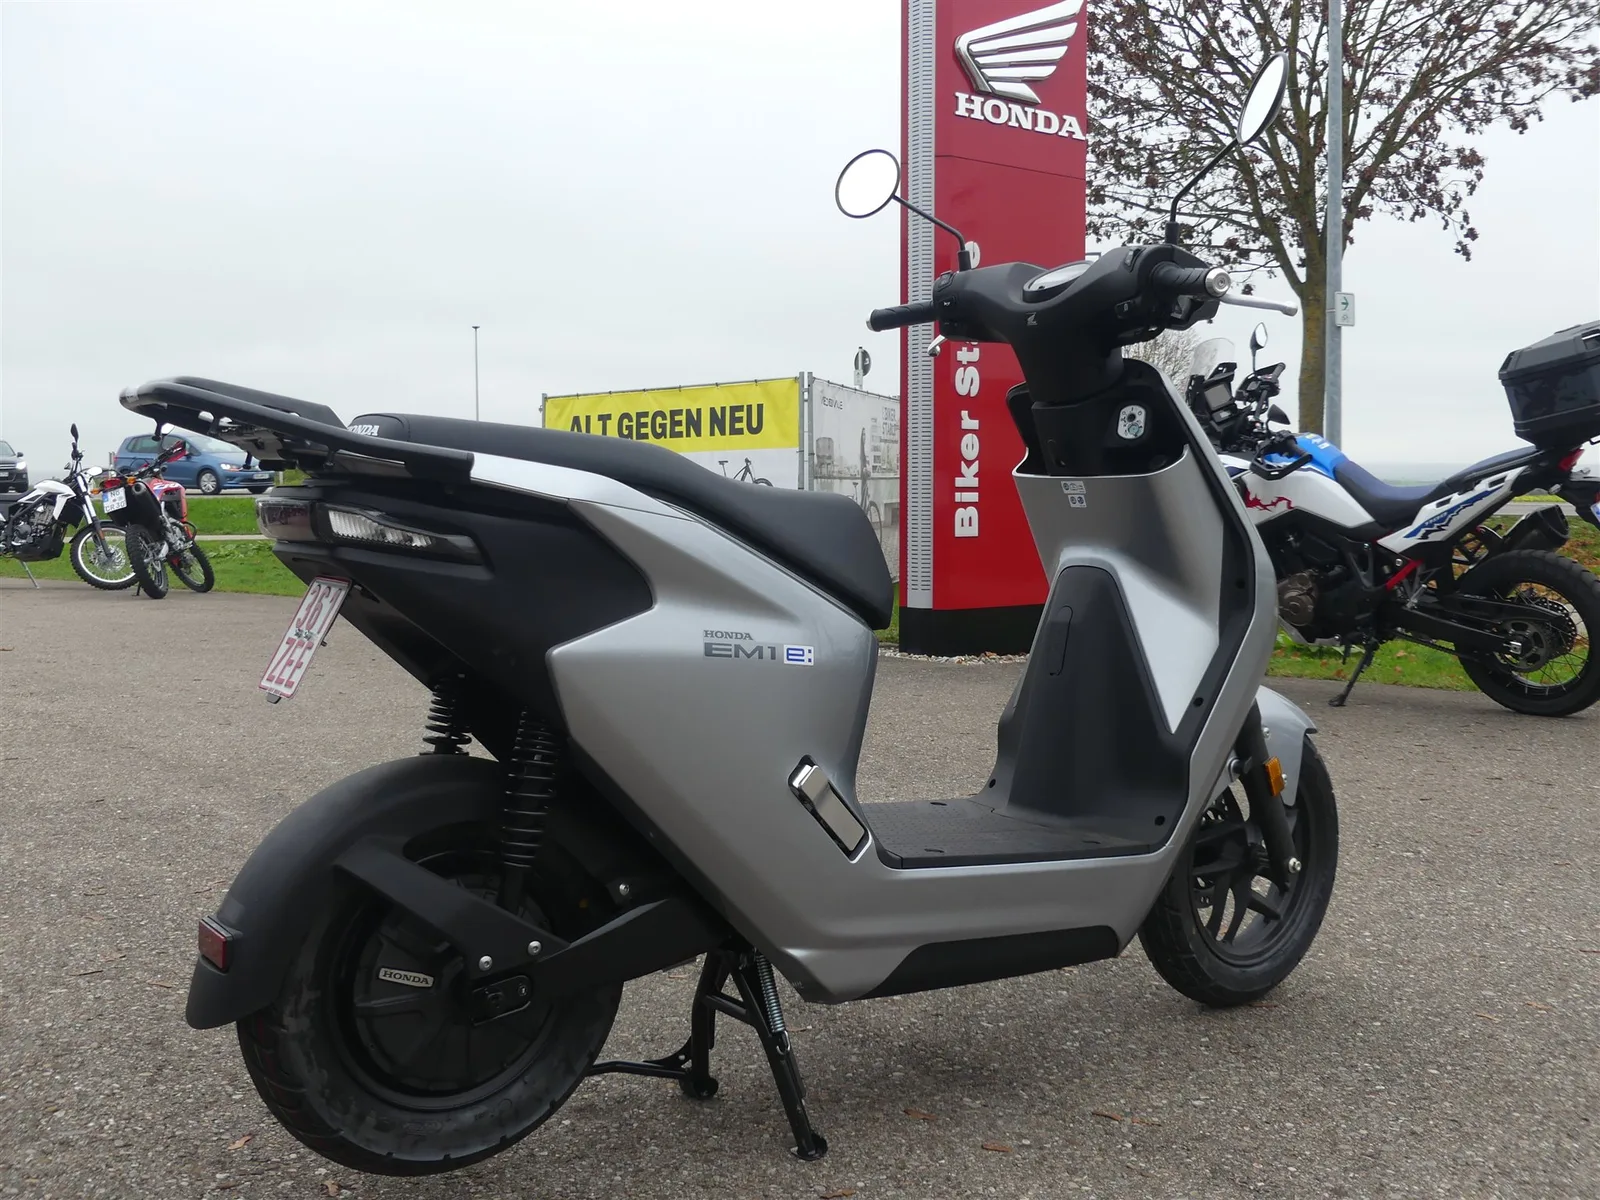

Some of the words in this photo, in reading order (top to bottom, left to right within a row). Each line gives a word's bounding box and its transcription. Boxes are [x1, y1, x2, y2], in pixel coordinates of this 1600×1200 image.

[955, 92, 1085, 141] HONDA
[955, 241, 980, 397] Ste
[347, 424, 380, 437] ONDA
[570, 413, 612, 436] ALT
[617, 408, 702, 440] GEGEN
[709, 403, 764, 436] NEU
[955, 410, 980, 537] Biker
[703, 630, 754, 641] HONDA
[704, 642, 776, 660] EM1
[266, 637, 314, 688] ZEE
[382, 970, 430, 985] HONDA
